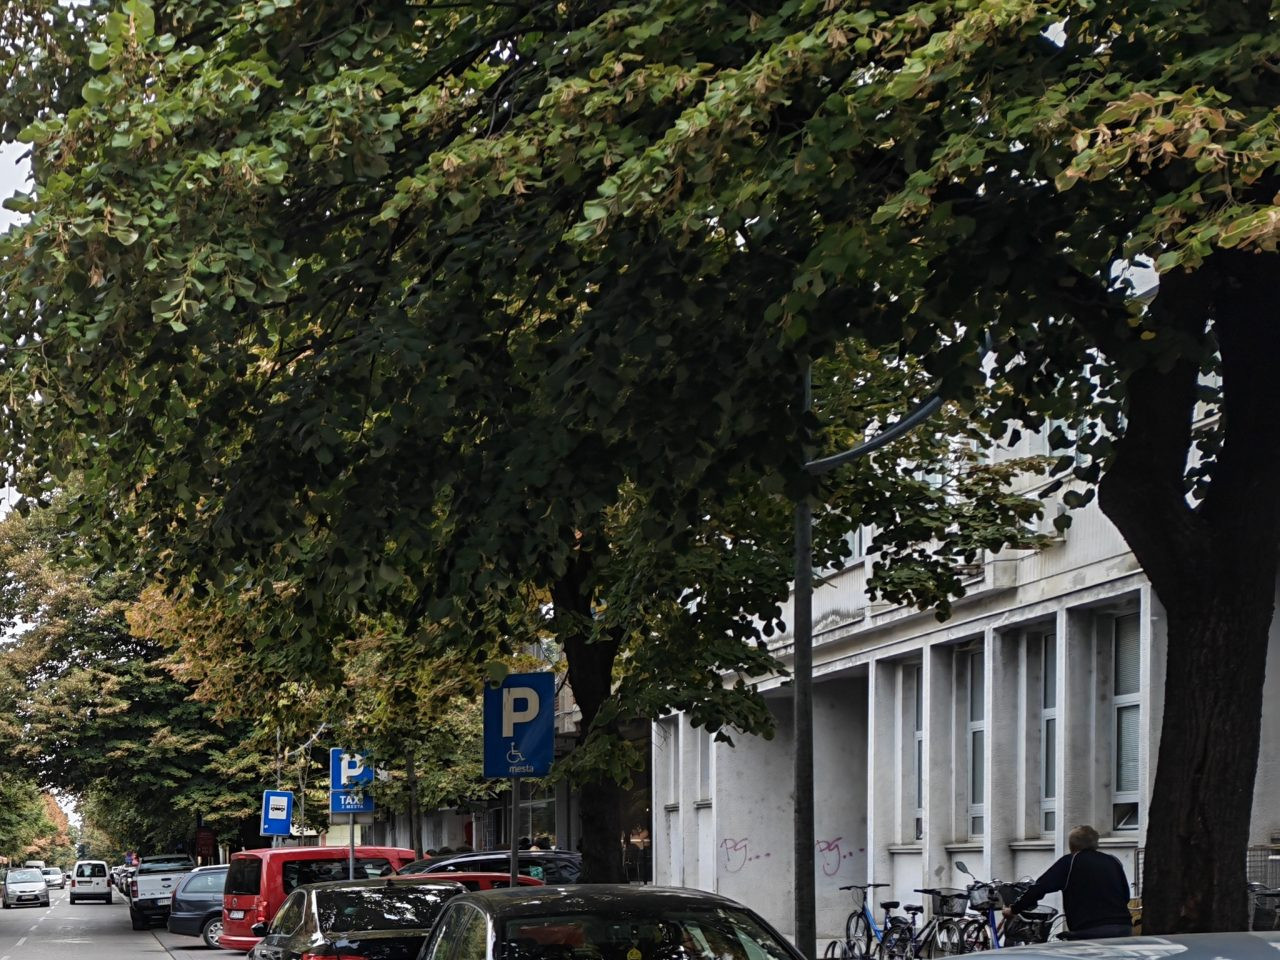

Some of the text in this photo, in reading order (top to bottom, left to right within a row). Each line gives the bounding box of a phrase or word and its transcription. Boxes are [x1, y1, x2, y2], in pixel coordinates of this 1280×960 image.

[503, 687, 540, 737] P
[340, 753, 364, 785] P
[509, 764, 535, 773] mesta
